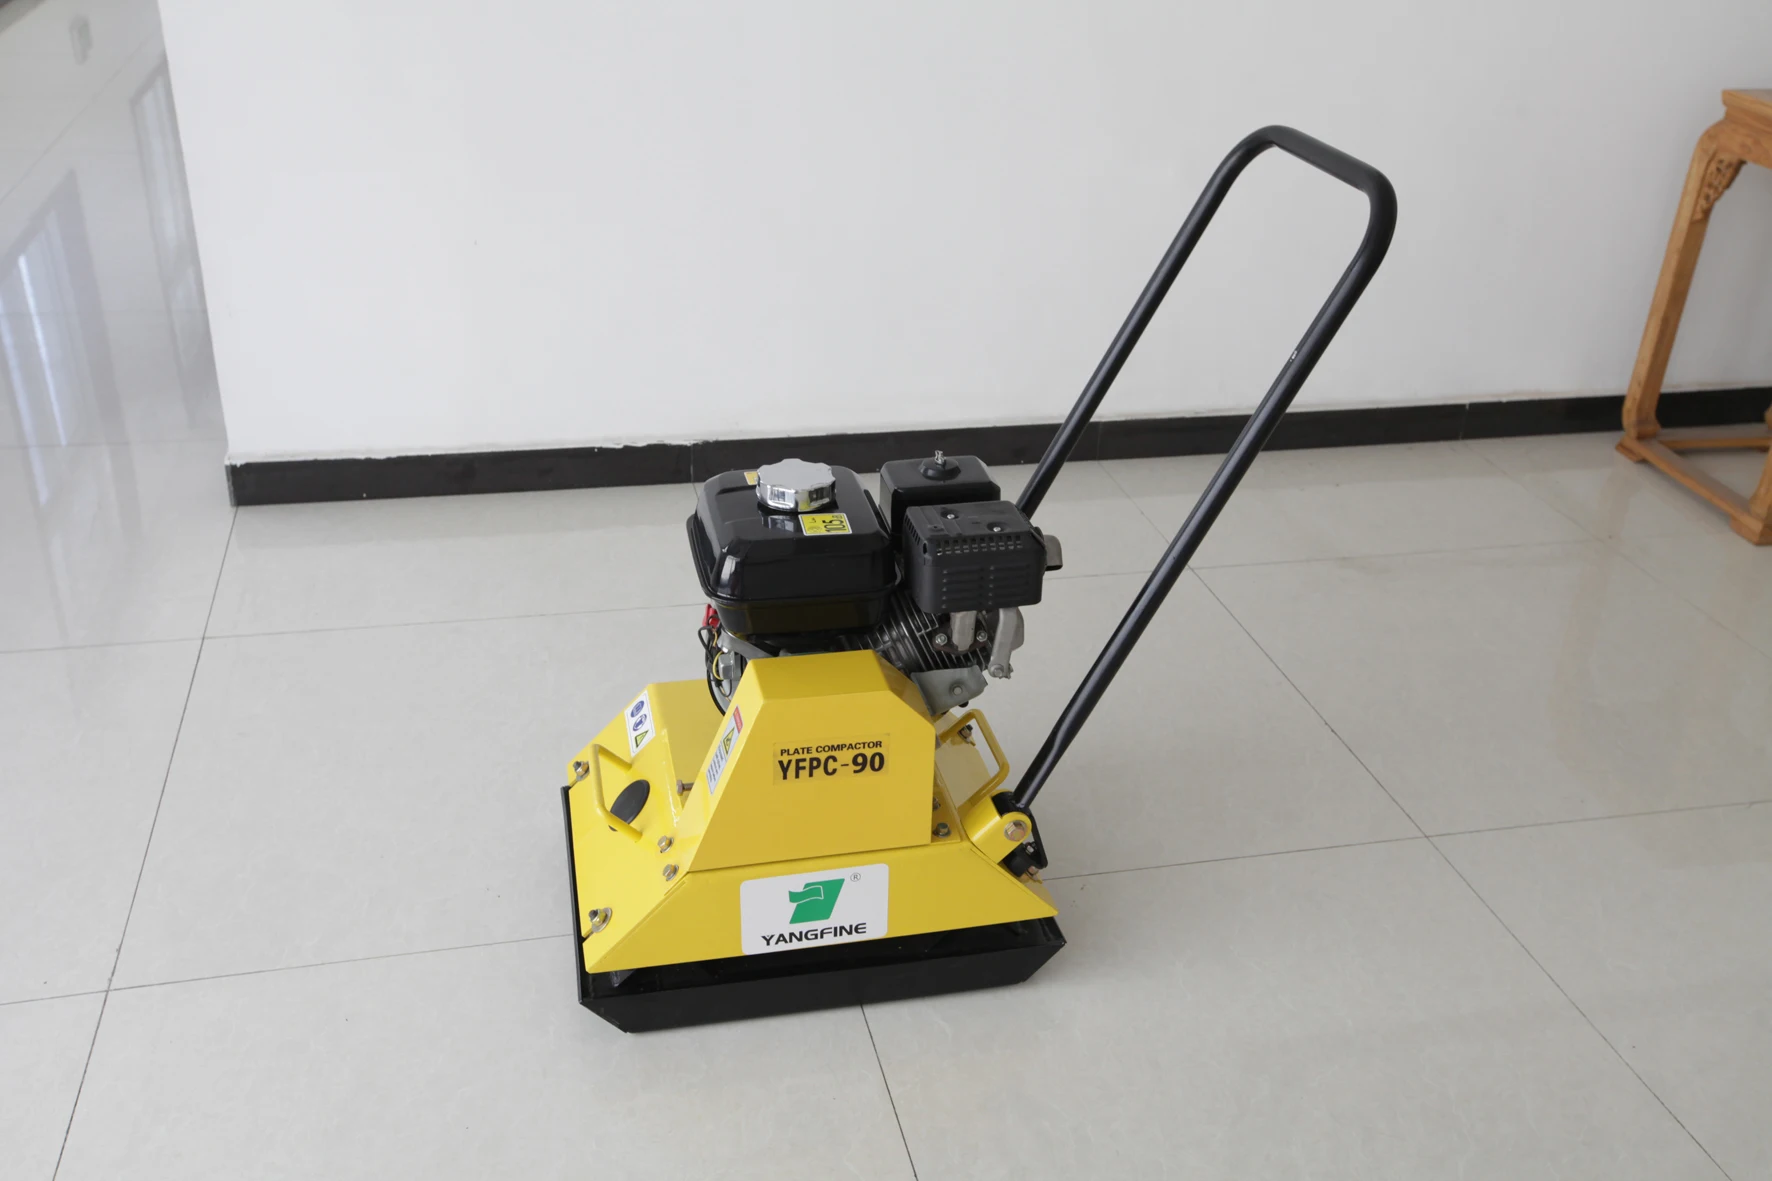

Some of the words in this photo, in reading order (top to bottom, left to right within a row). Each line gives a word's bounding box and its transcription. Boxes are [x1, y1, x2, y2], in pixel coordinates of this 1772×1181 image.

[780, 746, 813, 756] PLATE
[815, 740, 883, 754] COMPACTOR
[777, 752, 885, 780] YFPC-90
[760, 922, 867, 946] YANGFINE
